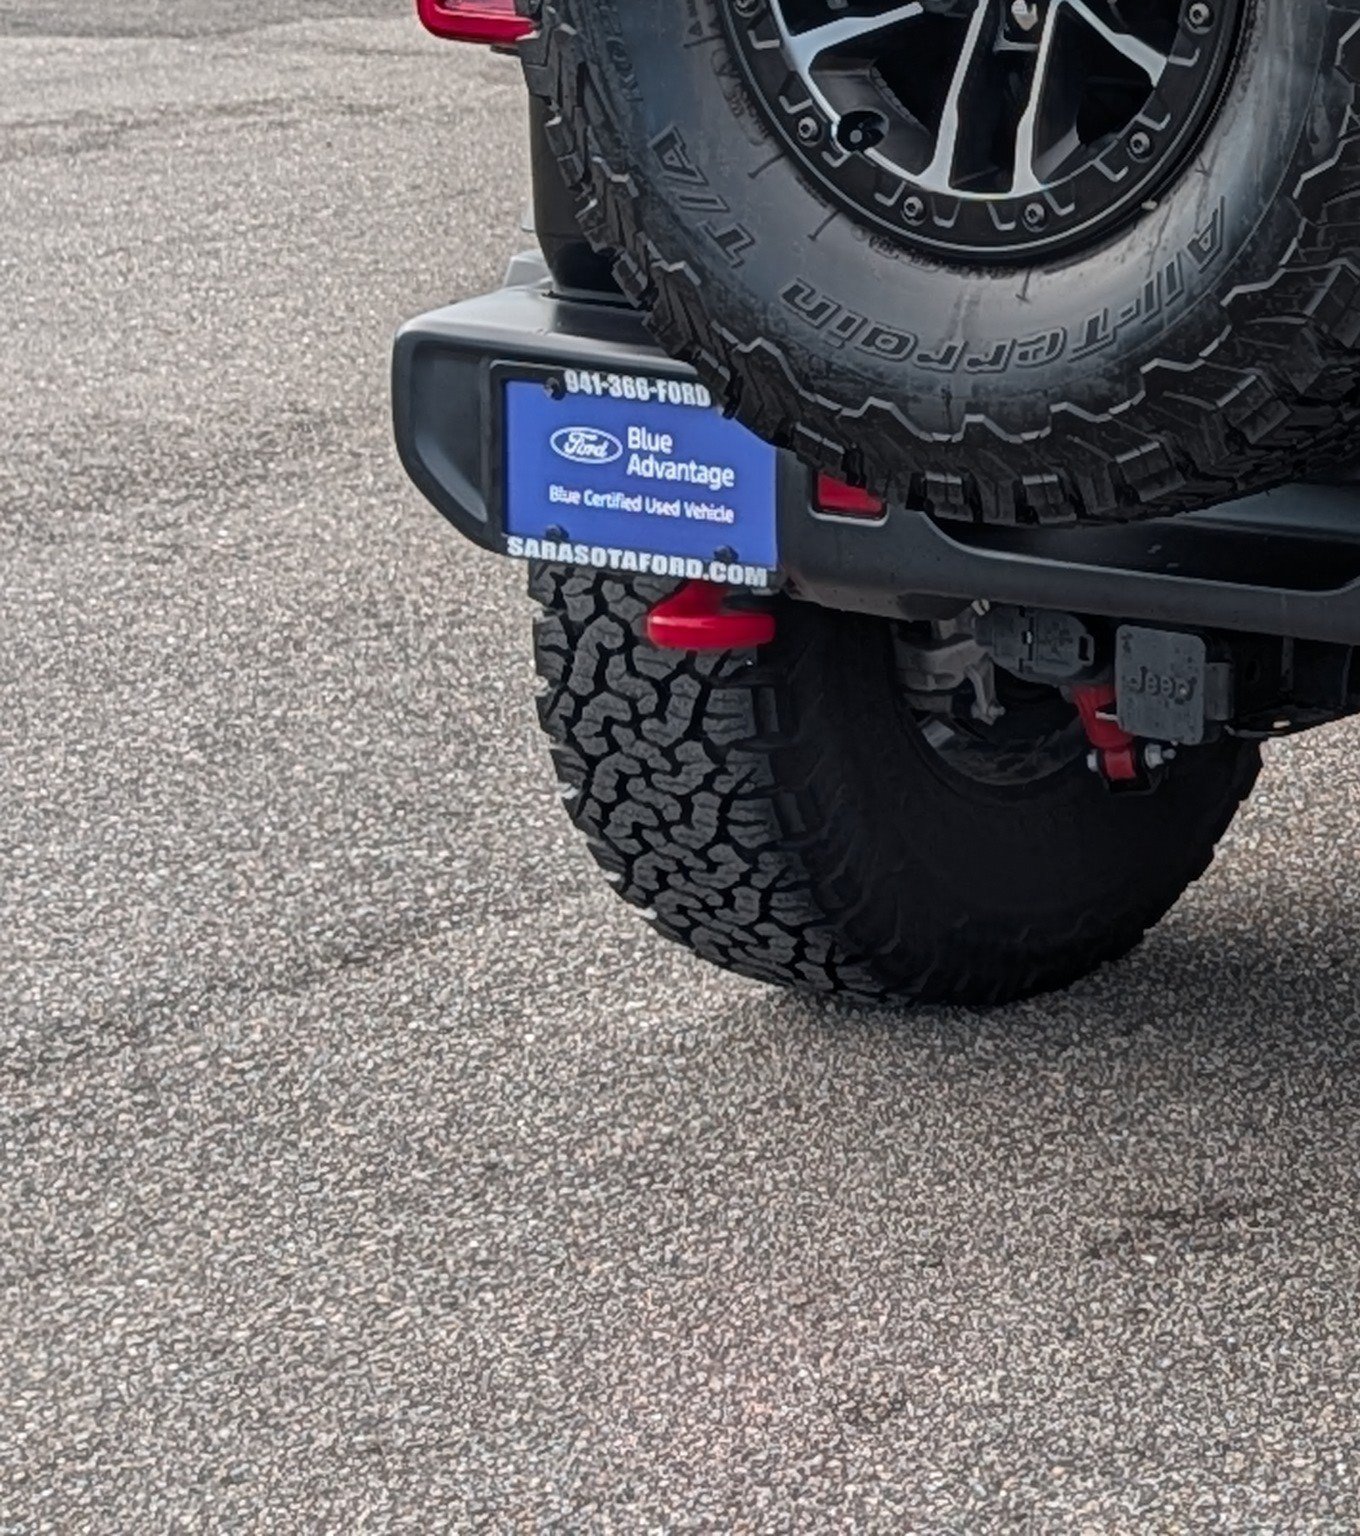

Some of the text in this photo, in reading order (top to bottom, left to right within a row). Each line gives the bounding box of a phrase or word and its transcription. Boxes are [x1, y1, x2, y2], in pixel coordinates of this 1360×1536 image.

[648, 124, 1227, 372] All-Terrain T/A
[563, 430, 610, 459] Ford
[627, 426, 673, 455] Blue
[626, 453, 735, 490] Advantage
[549, 484, 735, 524] Blue Certified Used Vehicle
[506, 535, 768, 587] SARASOTAFORD.COM
[1129, 665, 1198, 706] Jeep
